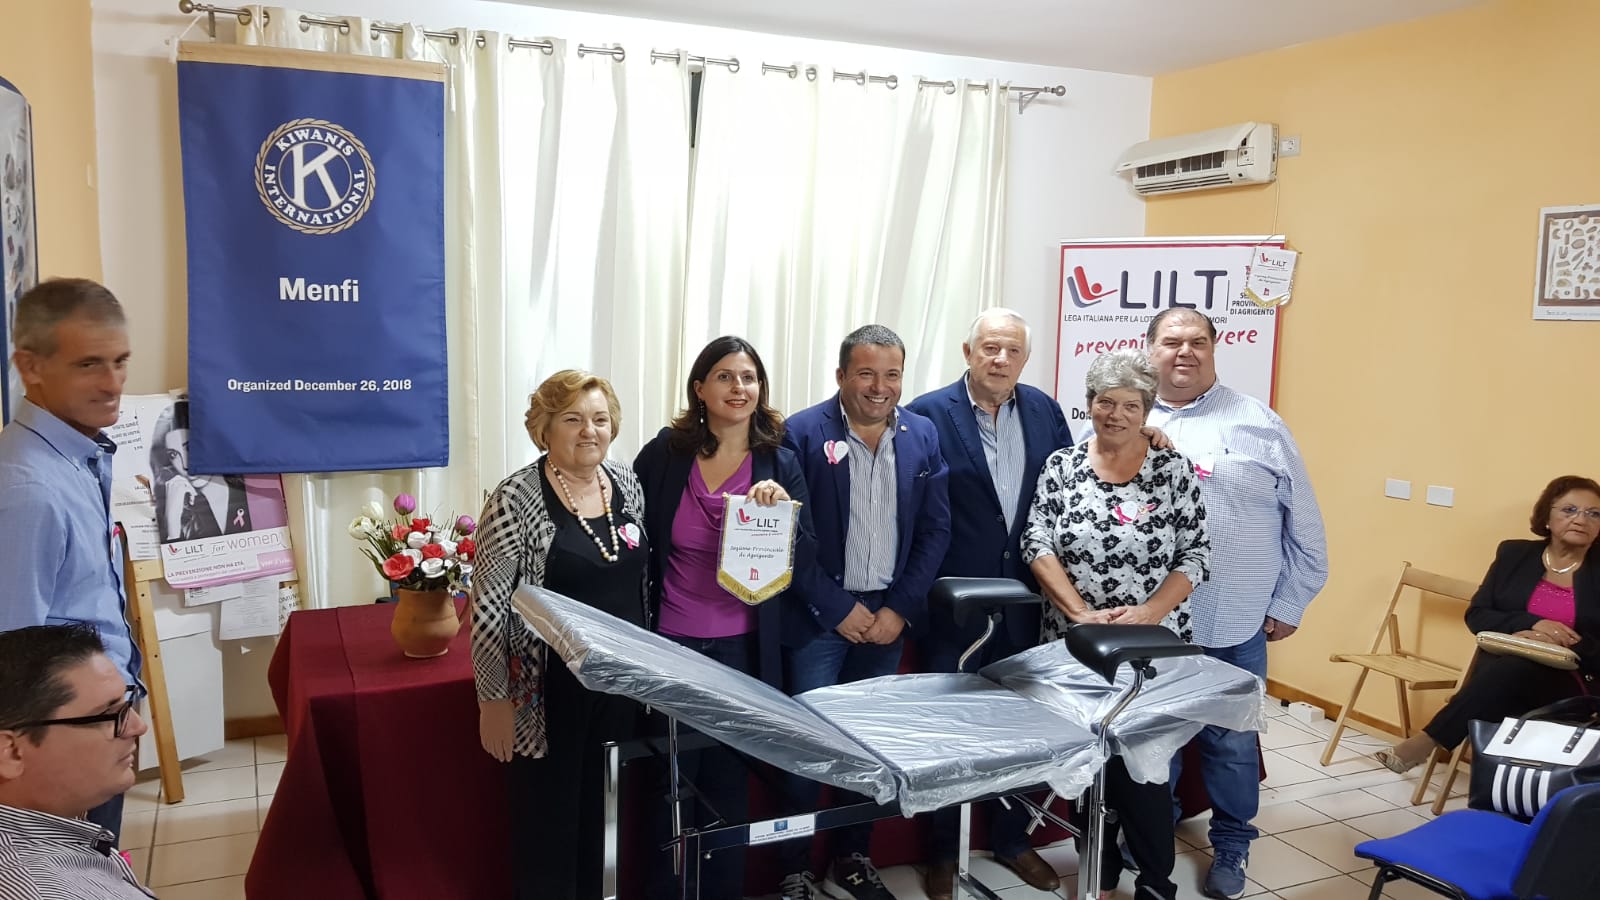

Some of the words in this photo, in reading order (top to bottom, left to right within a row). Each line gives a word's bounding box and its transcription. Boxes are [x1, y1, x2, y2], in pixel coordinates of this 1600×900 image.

[275, 128, 355, 156] KIWANIS
[290, 142, 342, 209] K
[264, 164, 365, 225] INTERNATIONAL
[1272, 259, 1288, 267] LILT
[279, 277, 359, 302] Menfi
[1119, 270, 1228, 310] LILT
[1064, 314, 1082, 322] LEGA
[1083, 314, 1114, 323] ITALIANA
[1115, 315, 1129, 323] PER
[1129, 315, 1139, 323] LA
[1140, 315, 1157, 323] LOT
[1209, 316, 1228, 324] MORI
[1238, 308, 1275, 316] AGRIGENTO
[1074, 332, 1147, 358] preveni
[227, 378, 292, 393] Organized
[295, 379, 357, 392] December
[360, 379, 380, 393] 26,
[382, 379, 412, 391] 2018
[757, 517, 780, 528] LILT
[184, 544, 204, 555] LILT
[211, 543, 225, 554] for
[227, 533, 279, 550] women
[175, 565, 213, 577] PREVENZIONE
[213, 563, 226, 571] NON
